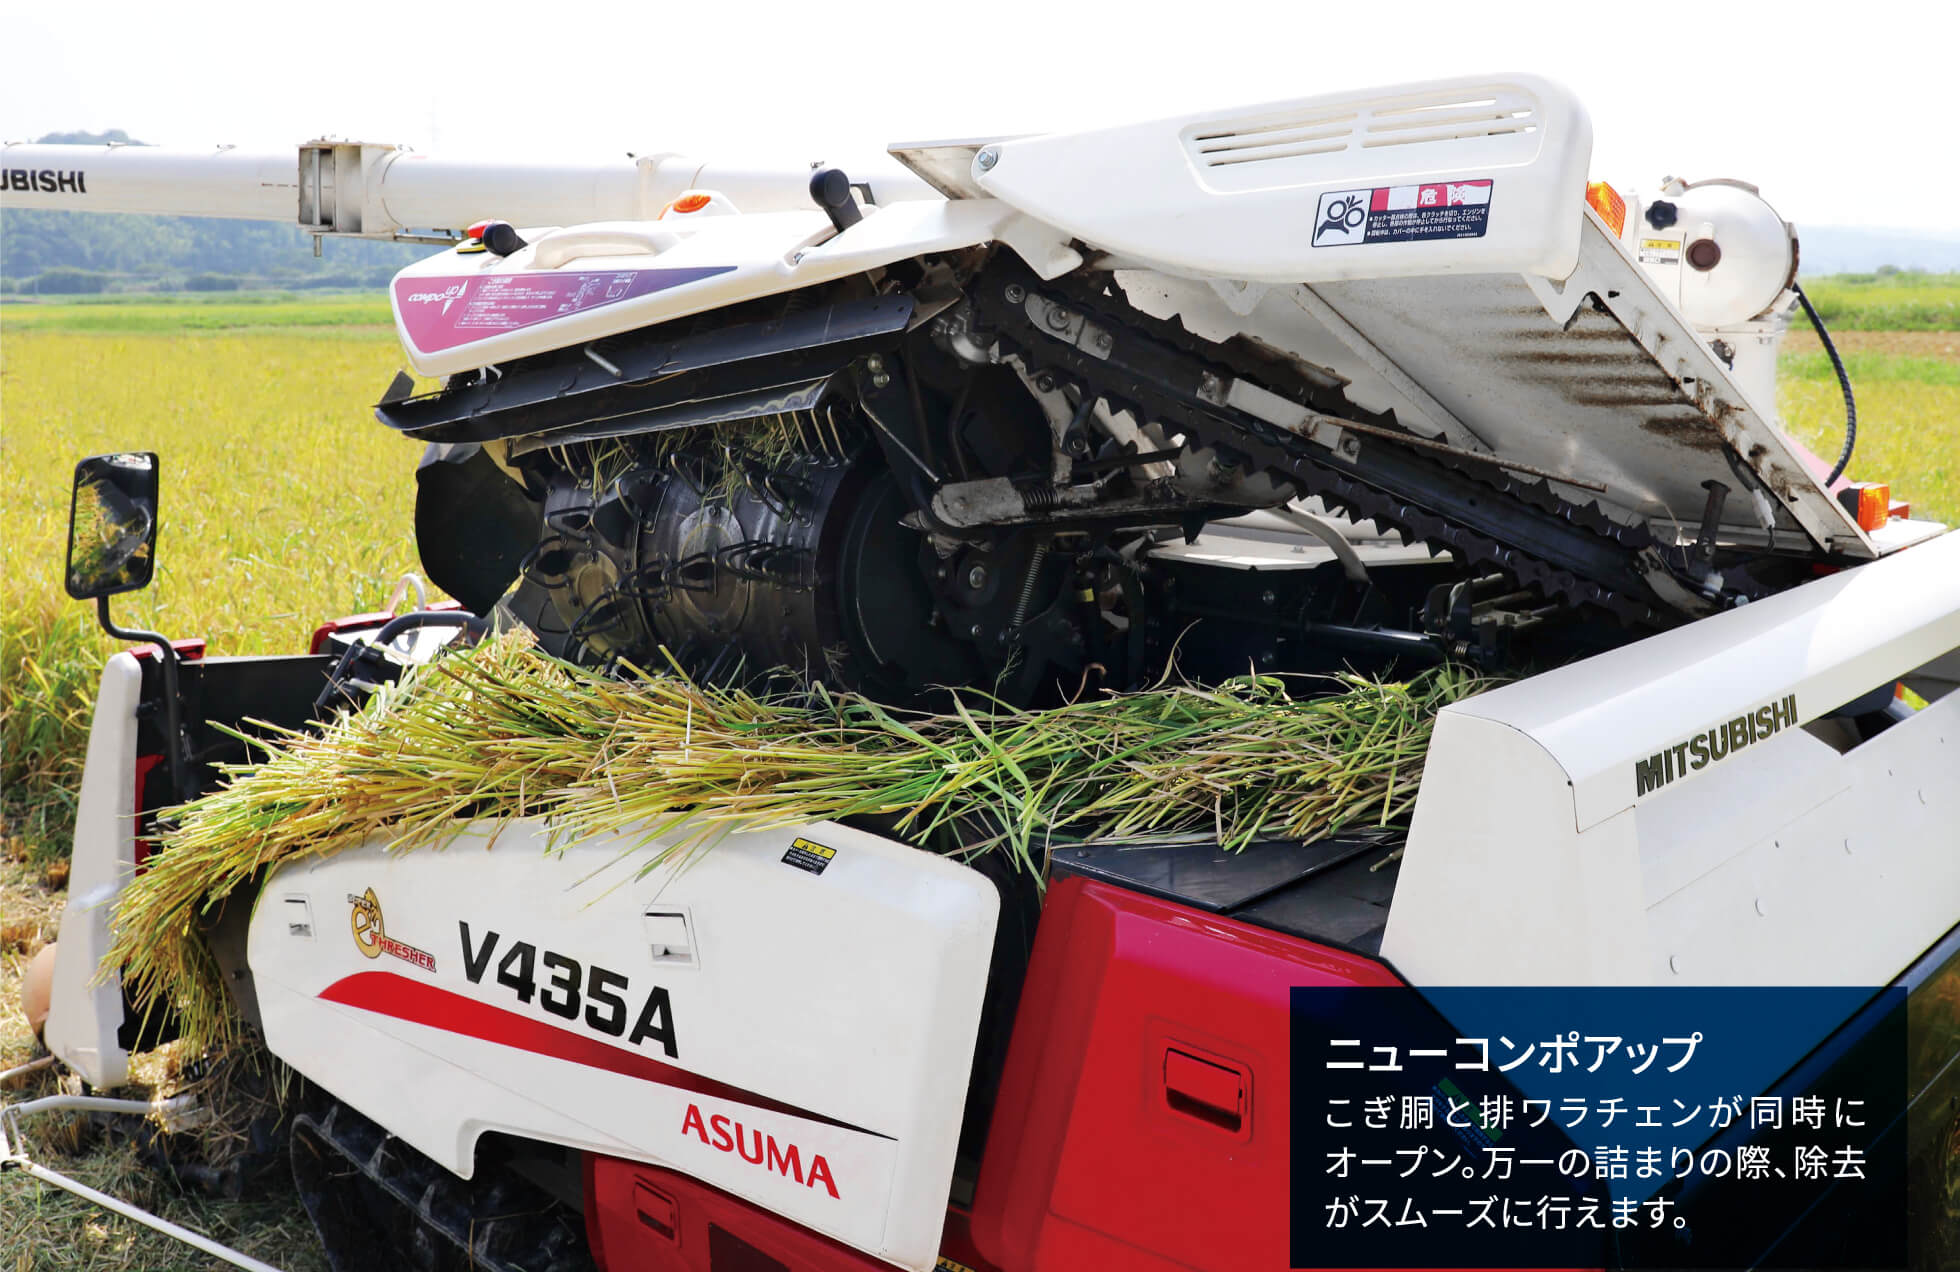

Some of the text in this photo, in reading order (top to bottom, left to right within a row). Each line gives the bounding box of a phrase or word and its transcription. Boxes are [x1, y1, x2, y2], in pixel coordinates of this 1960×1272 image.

[1635, 693, 1799, 798] MITSUBISHI
[370, 933, 435, 970] THRESHER
[458, 920, 679, 1060] V435A
[680, 1103, 841, 1200] ASUMA
